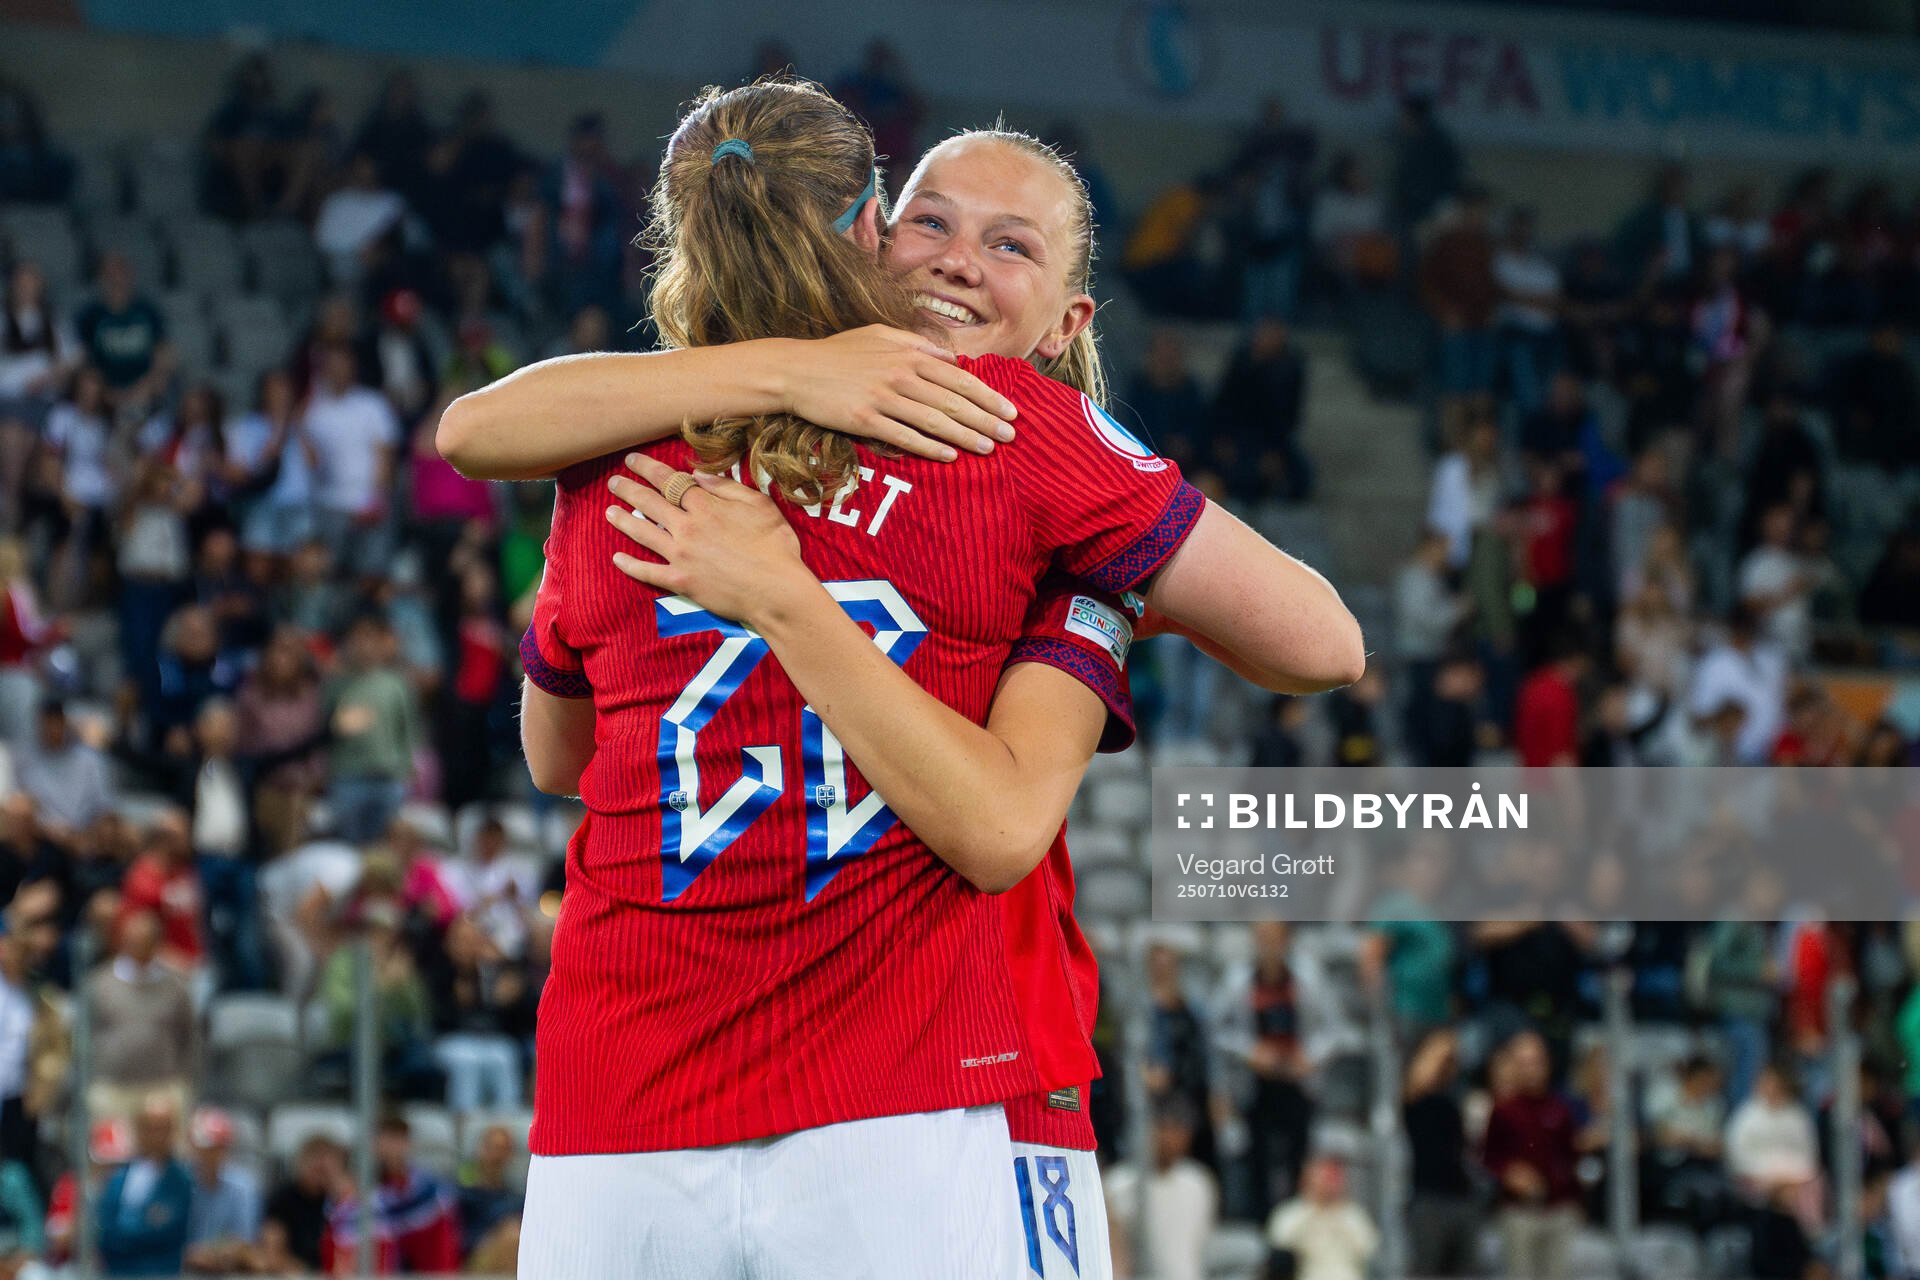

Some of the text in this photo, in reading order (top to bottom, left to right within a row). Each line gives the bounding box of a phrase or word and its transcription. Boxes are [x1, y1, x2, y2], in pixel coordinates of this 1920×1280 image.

[1320, 26, 1541, 115] UEFA
[1074, 597, 1096, 610] UEFA
[1014, 1156, 1080, 1280] 18
